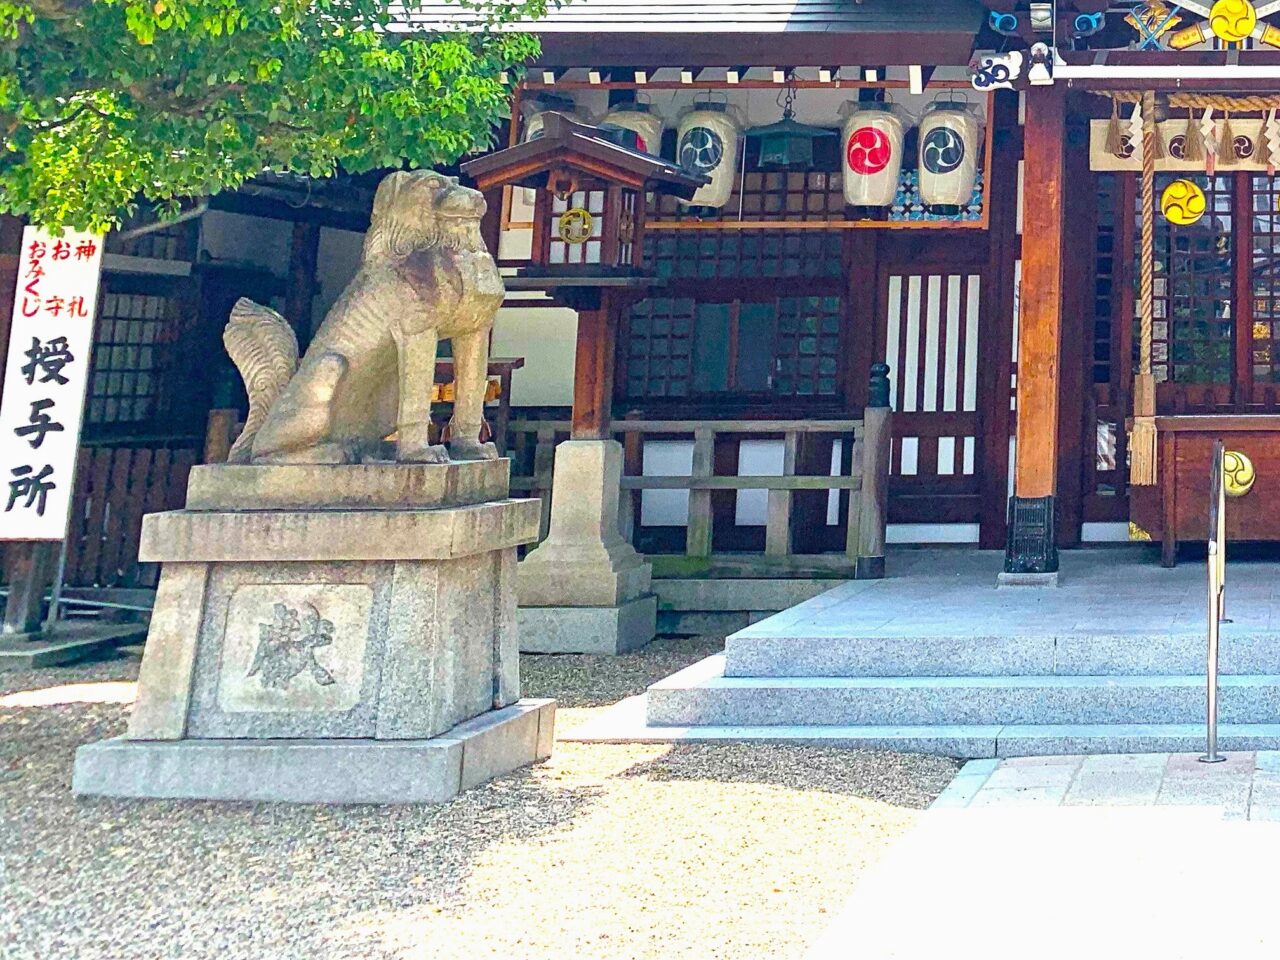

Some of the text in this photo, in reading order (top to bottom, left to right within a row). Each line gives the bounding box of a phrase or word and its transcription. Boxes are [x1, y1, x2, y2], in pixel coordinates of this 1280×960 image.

[22, 240, 47, 318] おみくじ
[45, 240, 71, 318] お守
[66, 240, 97, 318] 神札
[5, 336, 75, 517] 授与所
